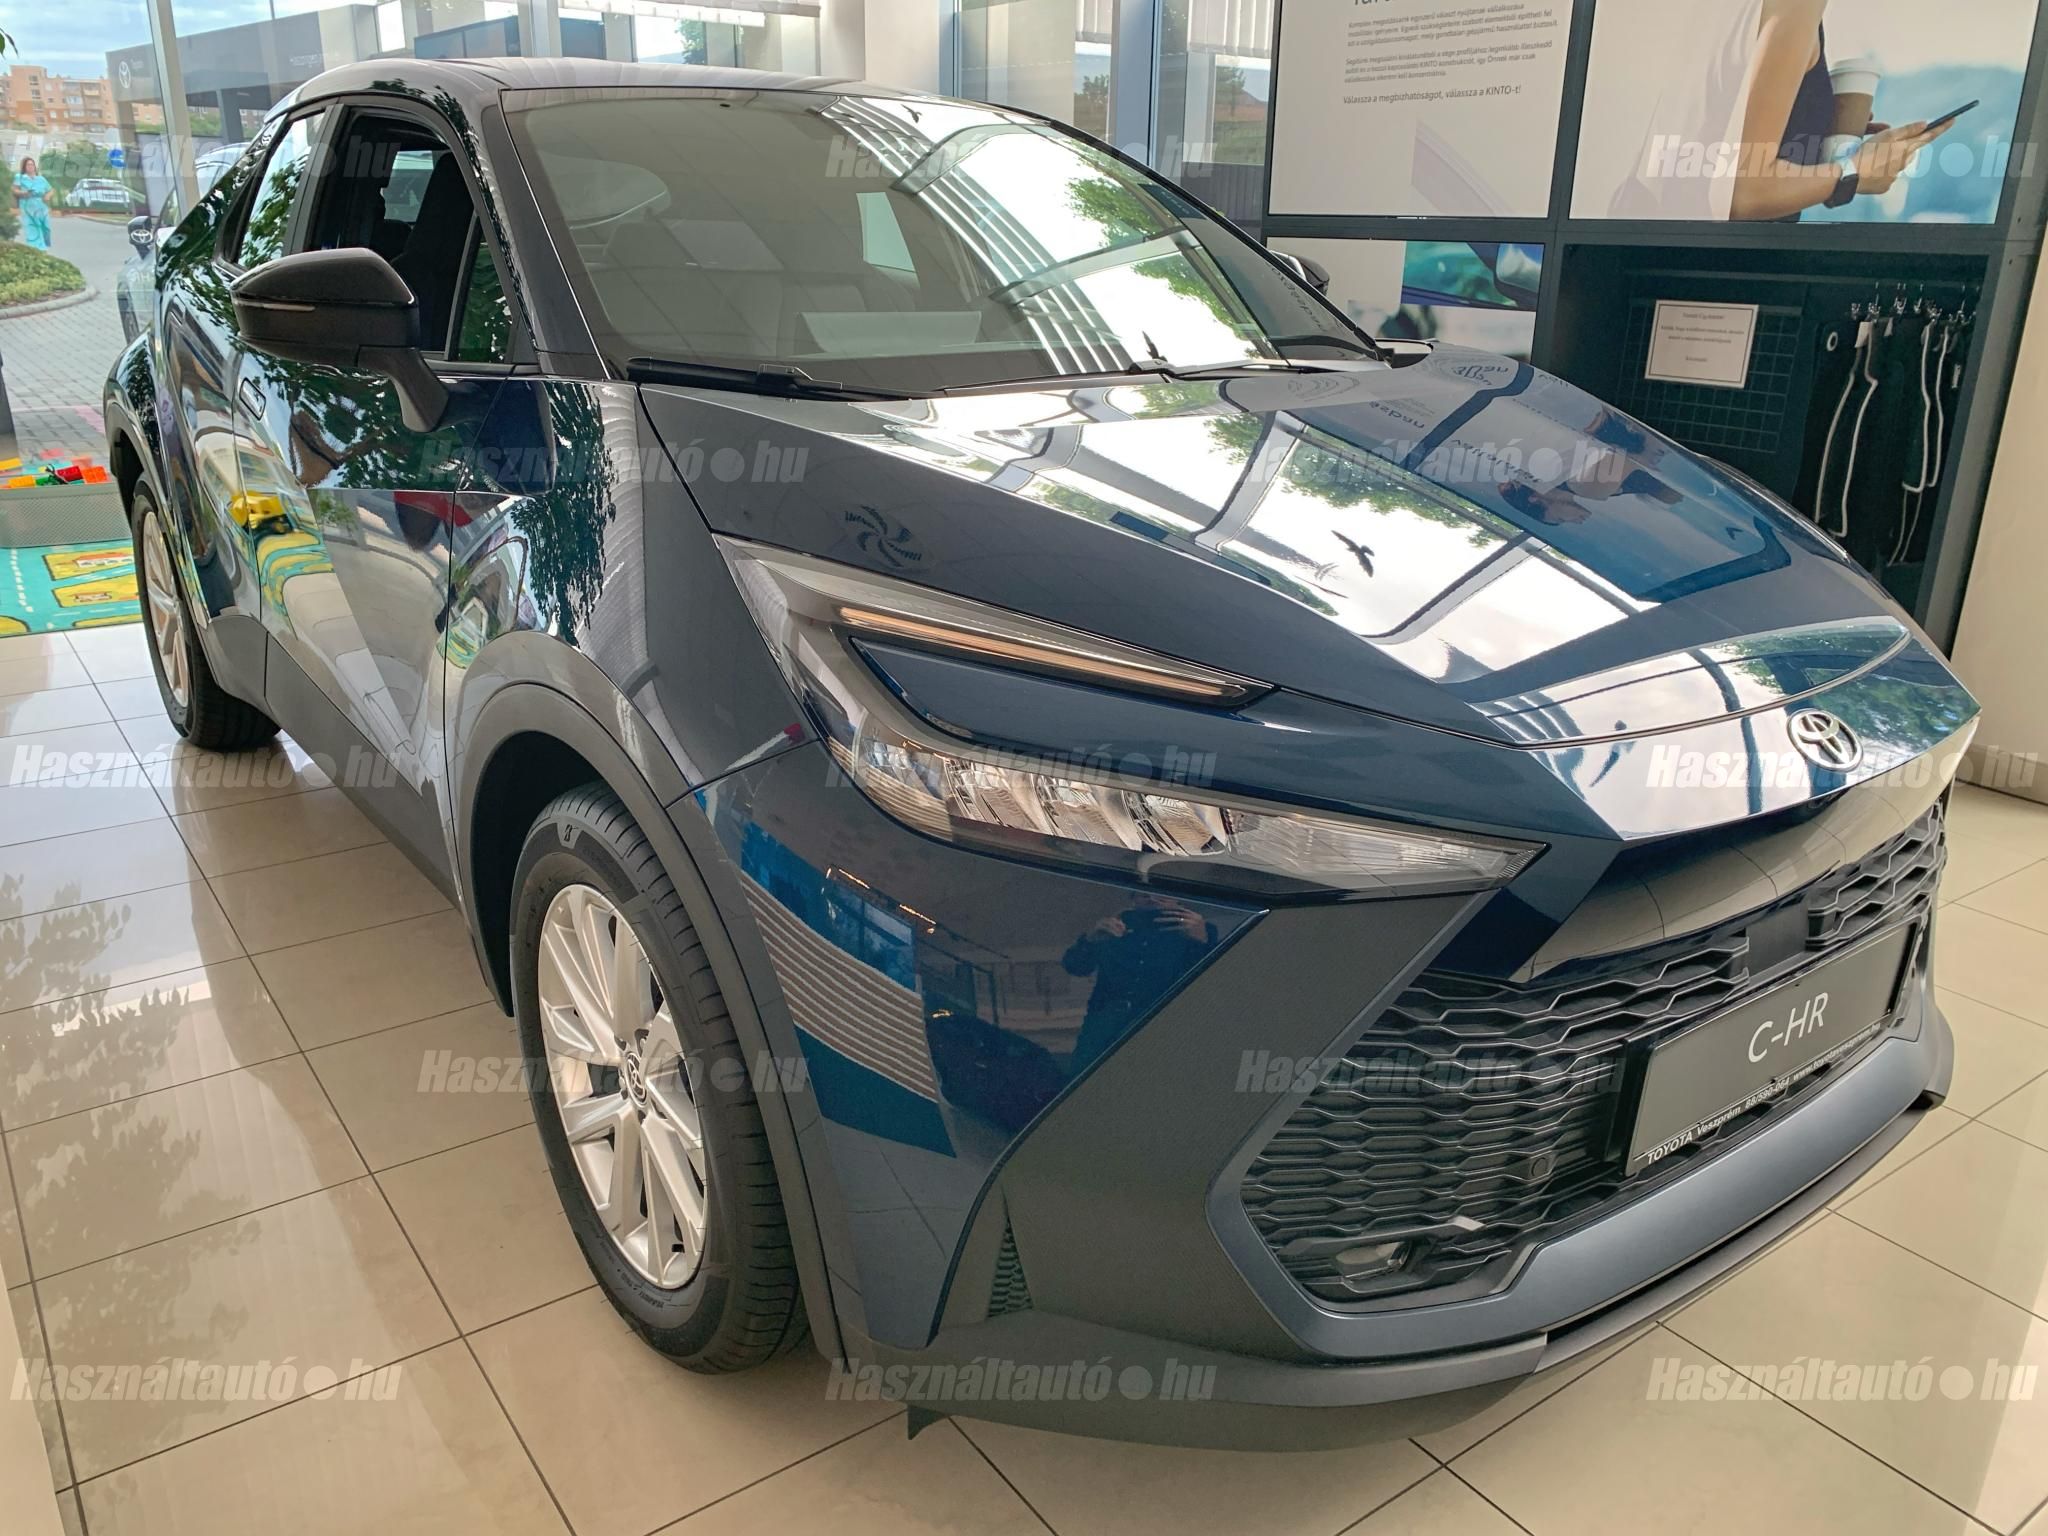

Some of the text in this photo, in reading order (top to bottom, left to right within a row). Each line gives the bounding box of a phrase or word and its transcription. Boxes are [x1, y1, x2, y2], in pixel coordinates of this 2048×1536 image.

[1486, 84, 1520, 95] KINTO-t!
[1748, 992, 1828, 1063] C-HR
[1647, 1132, 1693, 1165] TOYOTA
[1697, 1106, 1741, 1136] Veszprém
